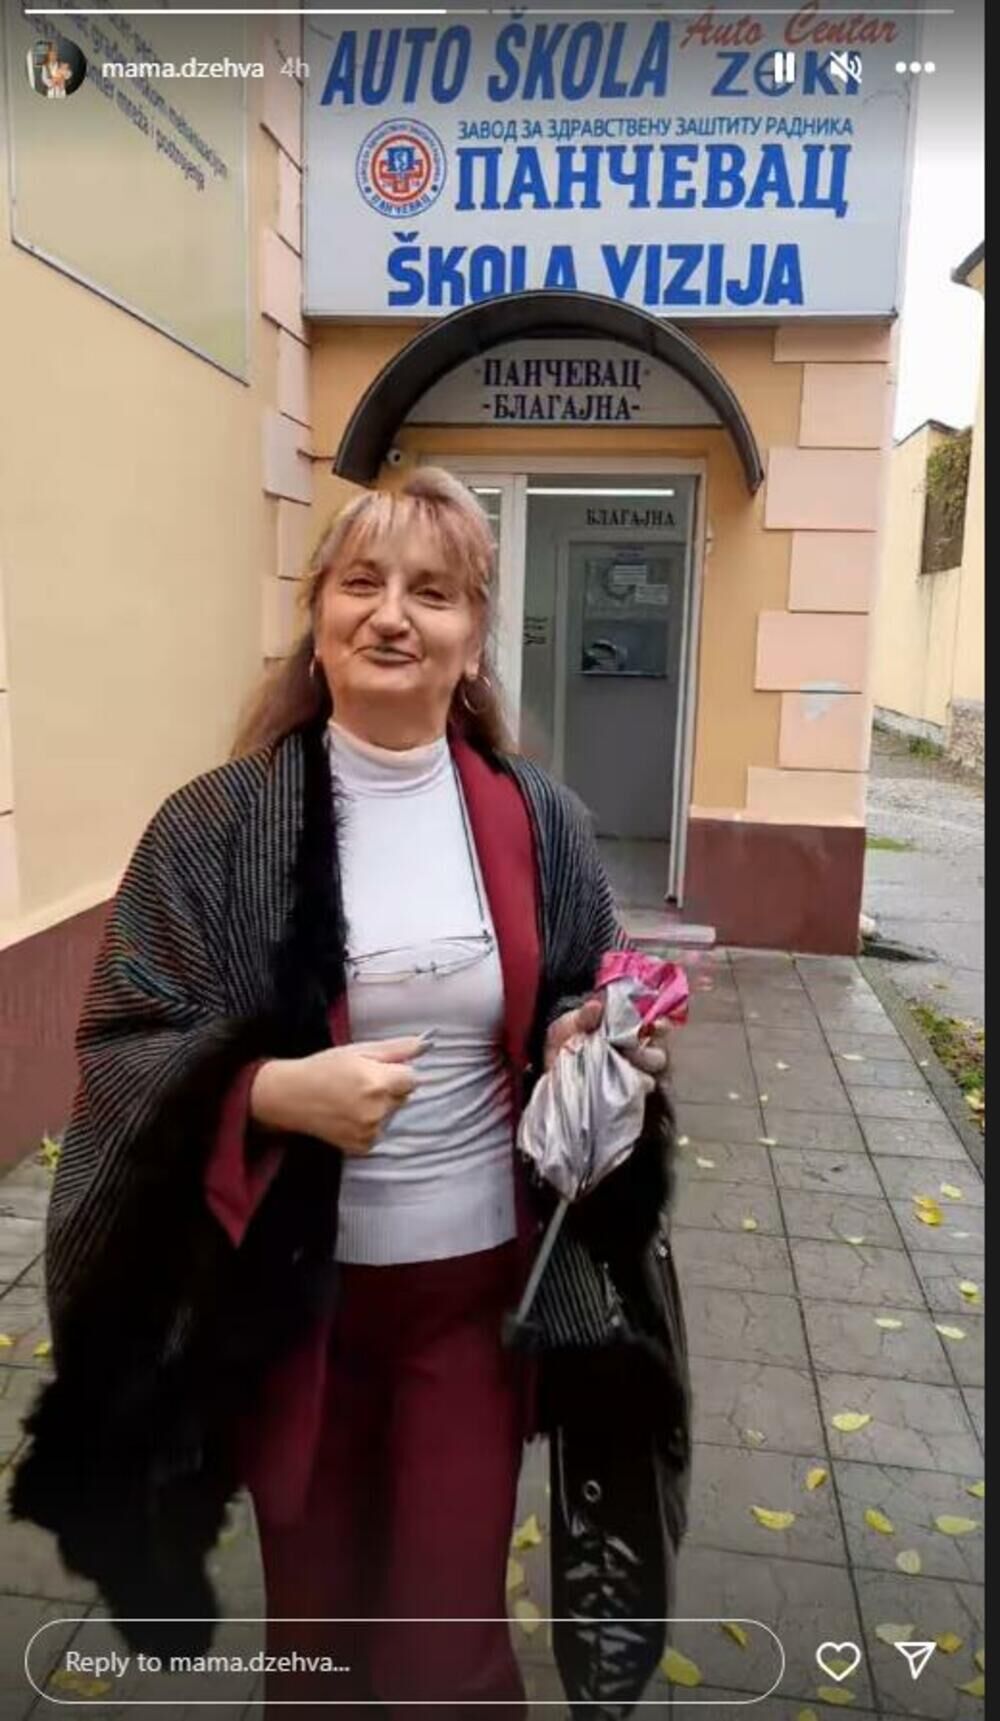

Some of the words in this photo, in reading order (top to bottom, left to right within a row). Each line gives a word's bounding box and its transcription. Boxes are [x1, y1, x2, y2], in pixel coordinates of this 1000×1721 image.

[680, 5, 763, 48] Auto
[784, 1, 898, 45] Centar
[321, 24, 472, 106] AUTO
[487, 7, 671, 103] ŠKOLA
[458, 119, 518, 142] ЗАВОД
[521, 117, 543, 139] ЗА
[547, 116, 672, 141] ЗДРАВСТВЕНУ
[675, 115, 761, 137] ЗАШТИТУ
[765, 114, 854, 139] РАДНИКА
[455, 143, 852, 218] ПАНЧЕВАЦ
[600, 243, 804, 307] VIZIJA
[483, 358, 642, 391] ПАНЧЕВАЦ
[586, 508, 676, 526] БЛАГАЈНА
